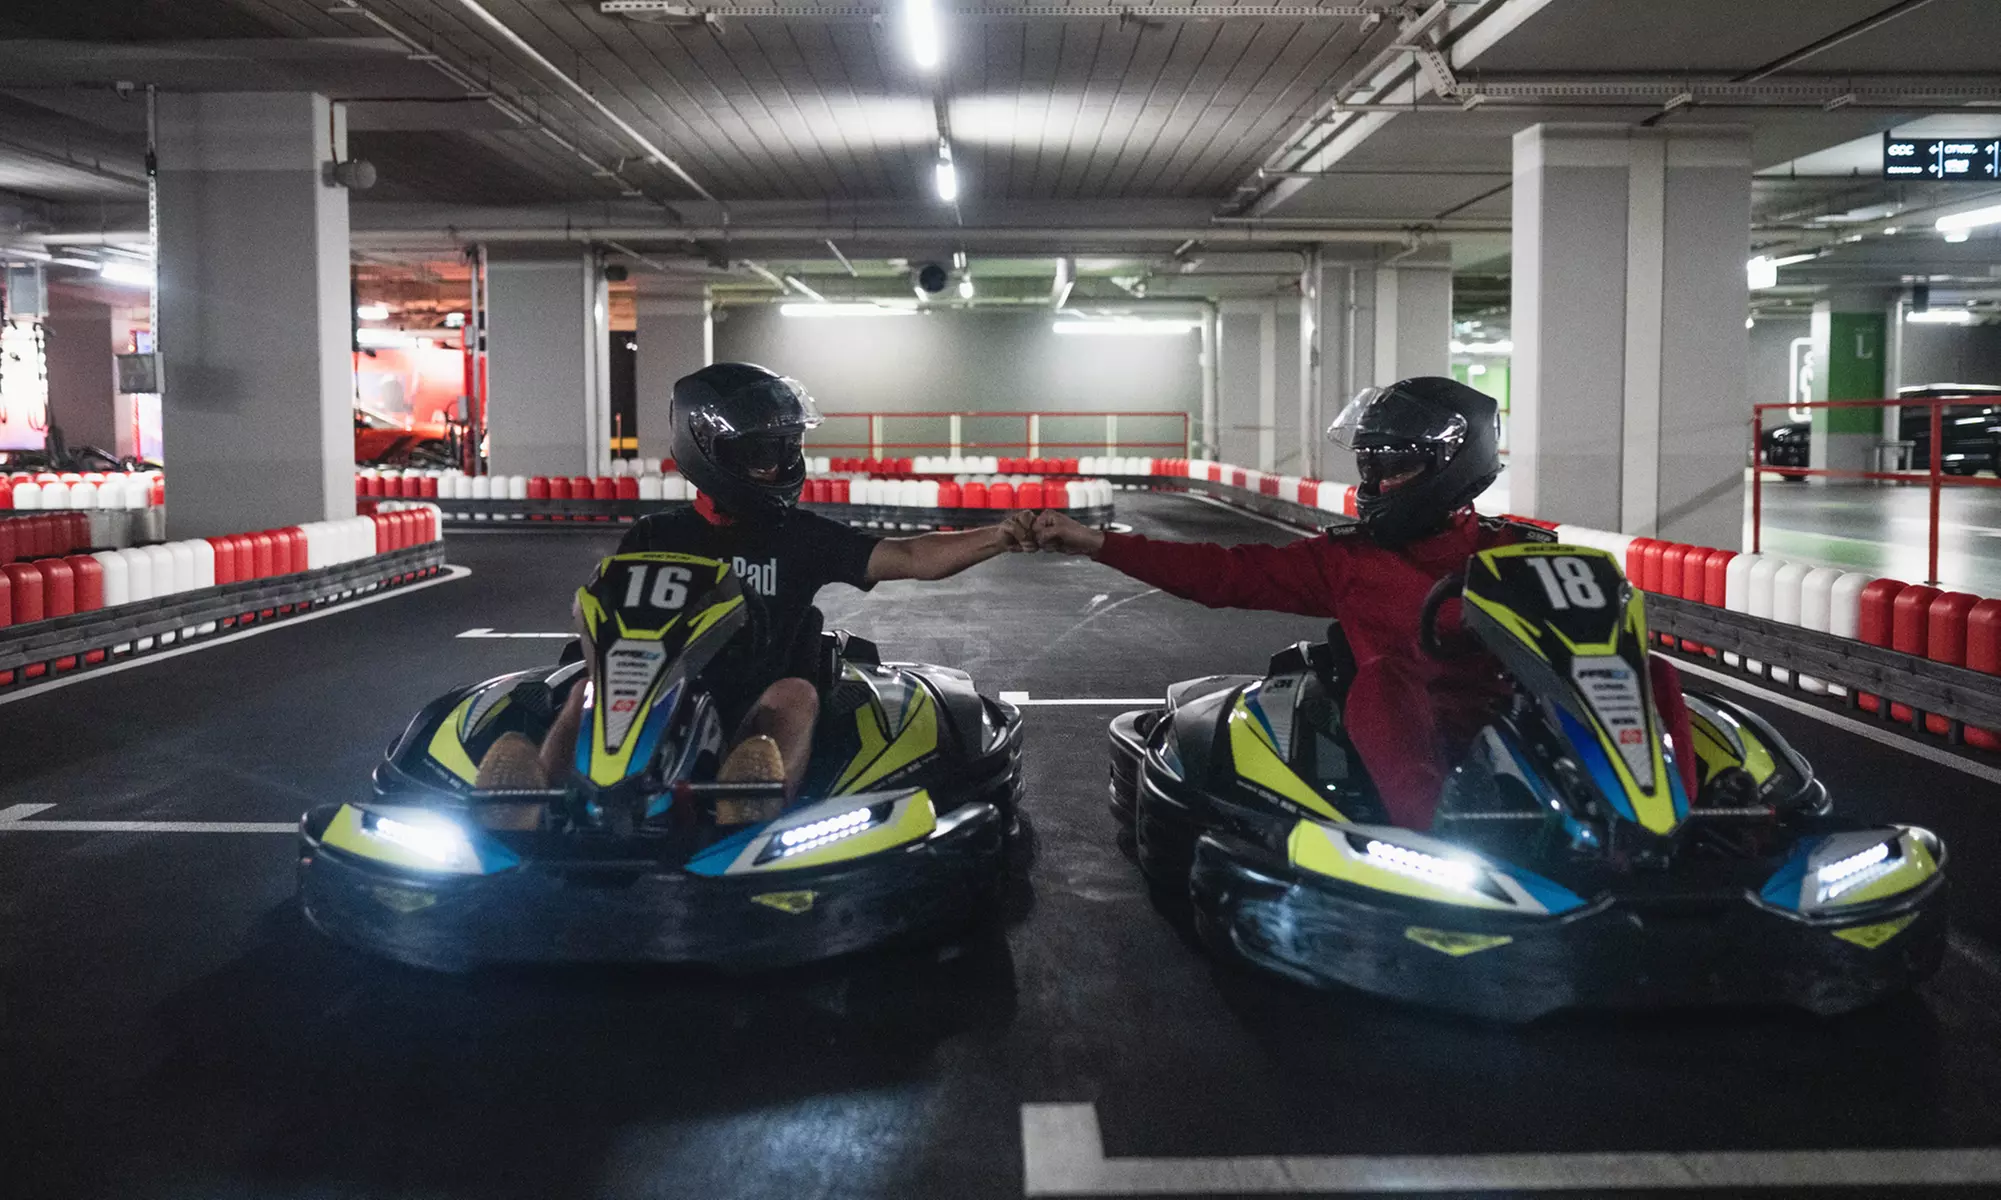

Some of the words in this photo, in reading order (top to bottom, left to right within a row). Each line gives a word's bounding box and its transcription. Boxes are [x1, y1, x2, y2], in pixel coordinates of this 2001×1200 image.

[623, 565, 692, 609] 16
[717, 556, 777, 596] Pad
[1525, 556, 1606, 609] 18
